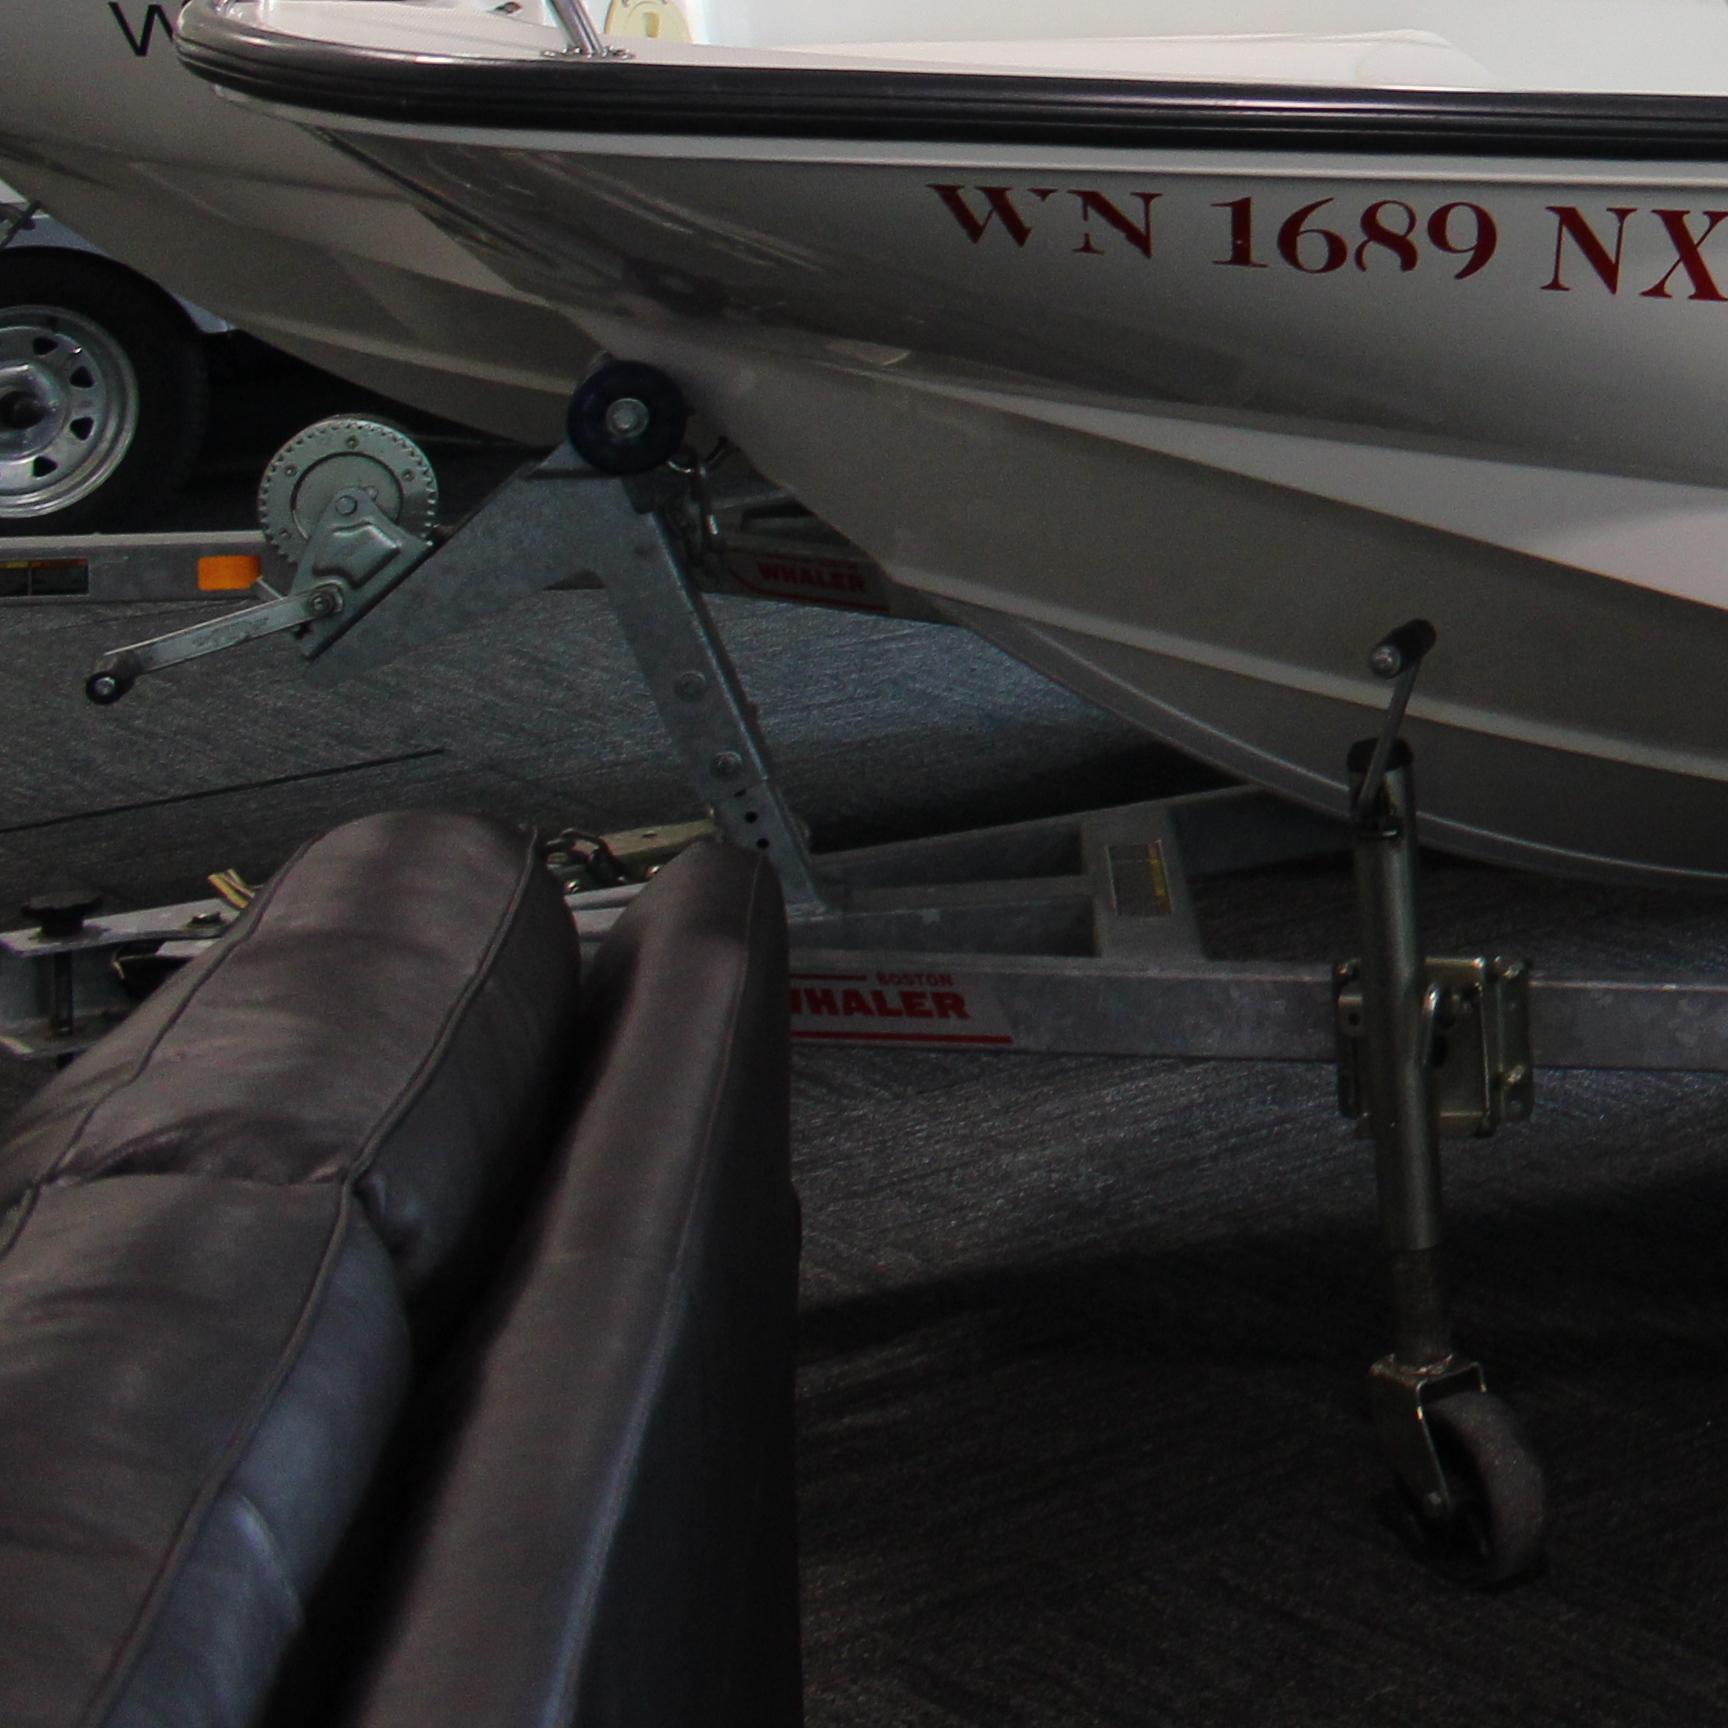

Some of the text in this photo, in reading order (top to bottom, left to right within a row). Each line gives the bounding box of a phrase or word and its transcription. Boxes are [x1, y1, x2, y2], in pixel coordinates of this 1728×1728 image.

[925, 183, 1163, 259] WN
[1210, 195, 1498, 280] 1689
[757, 562, 866, 593] WHALER
[876, 972, 954, 988] BOSTON
[789, 987, 971, 1020] HALER
